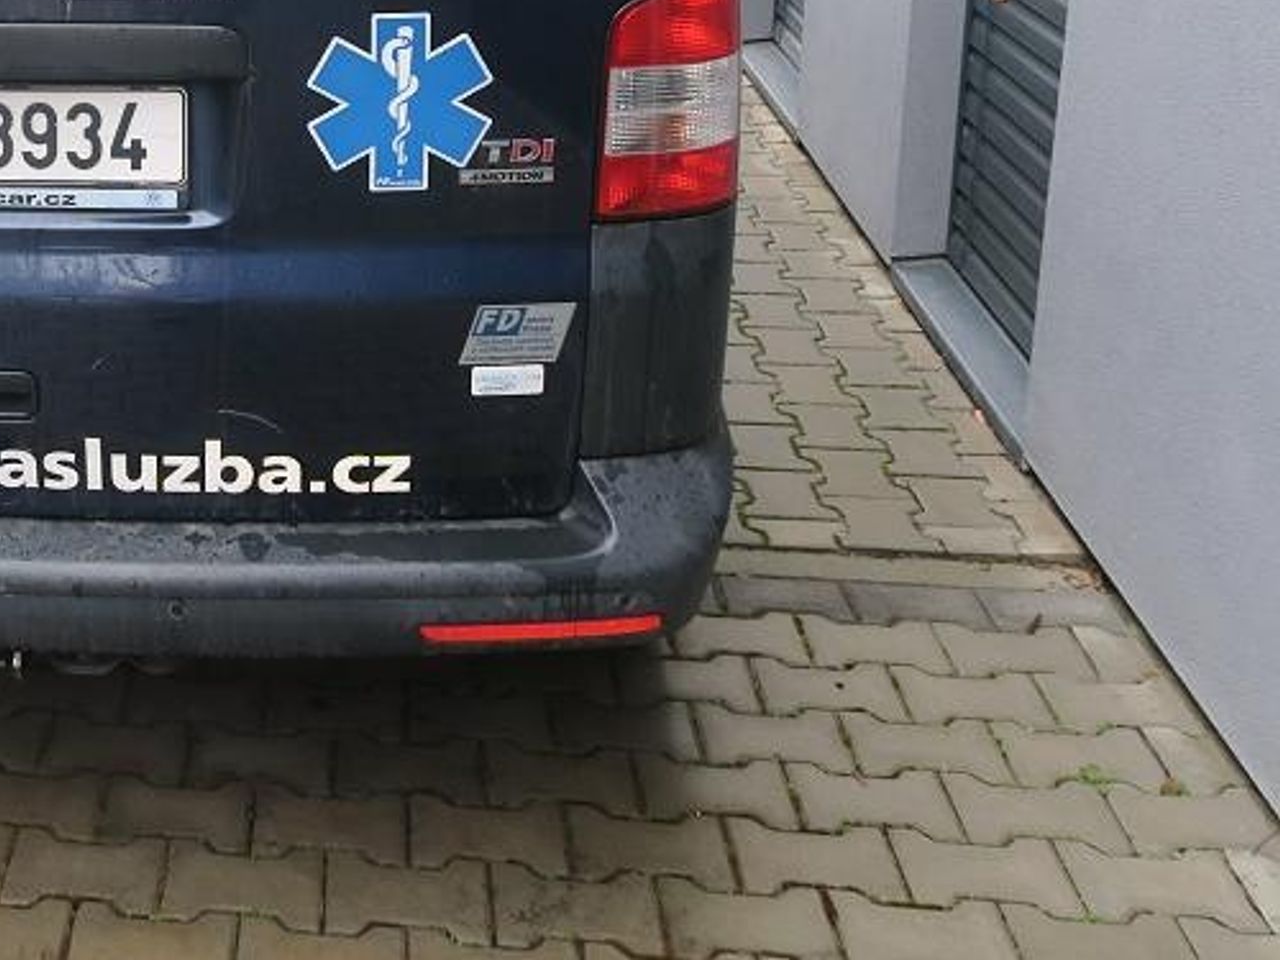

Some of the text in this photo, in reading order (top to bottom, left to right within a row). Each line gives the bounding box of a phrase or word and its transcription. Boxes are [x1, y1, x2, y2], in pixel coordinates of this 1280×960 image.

[481, 138, 555, 163] TDI
[469, 170, 545, 182] 4MOTION
[475, 308, 522, 334] FD
